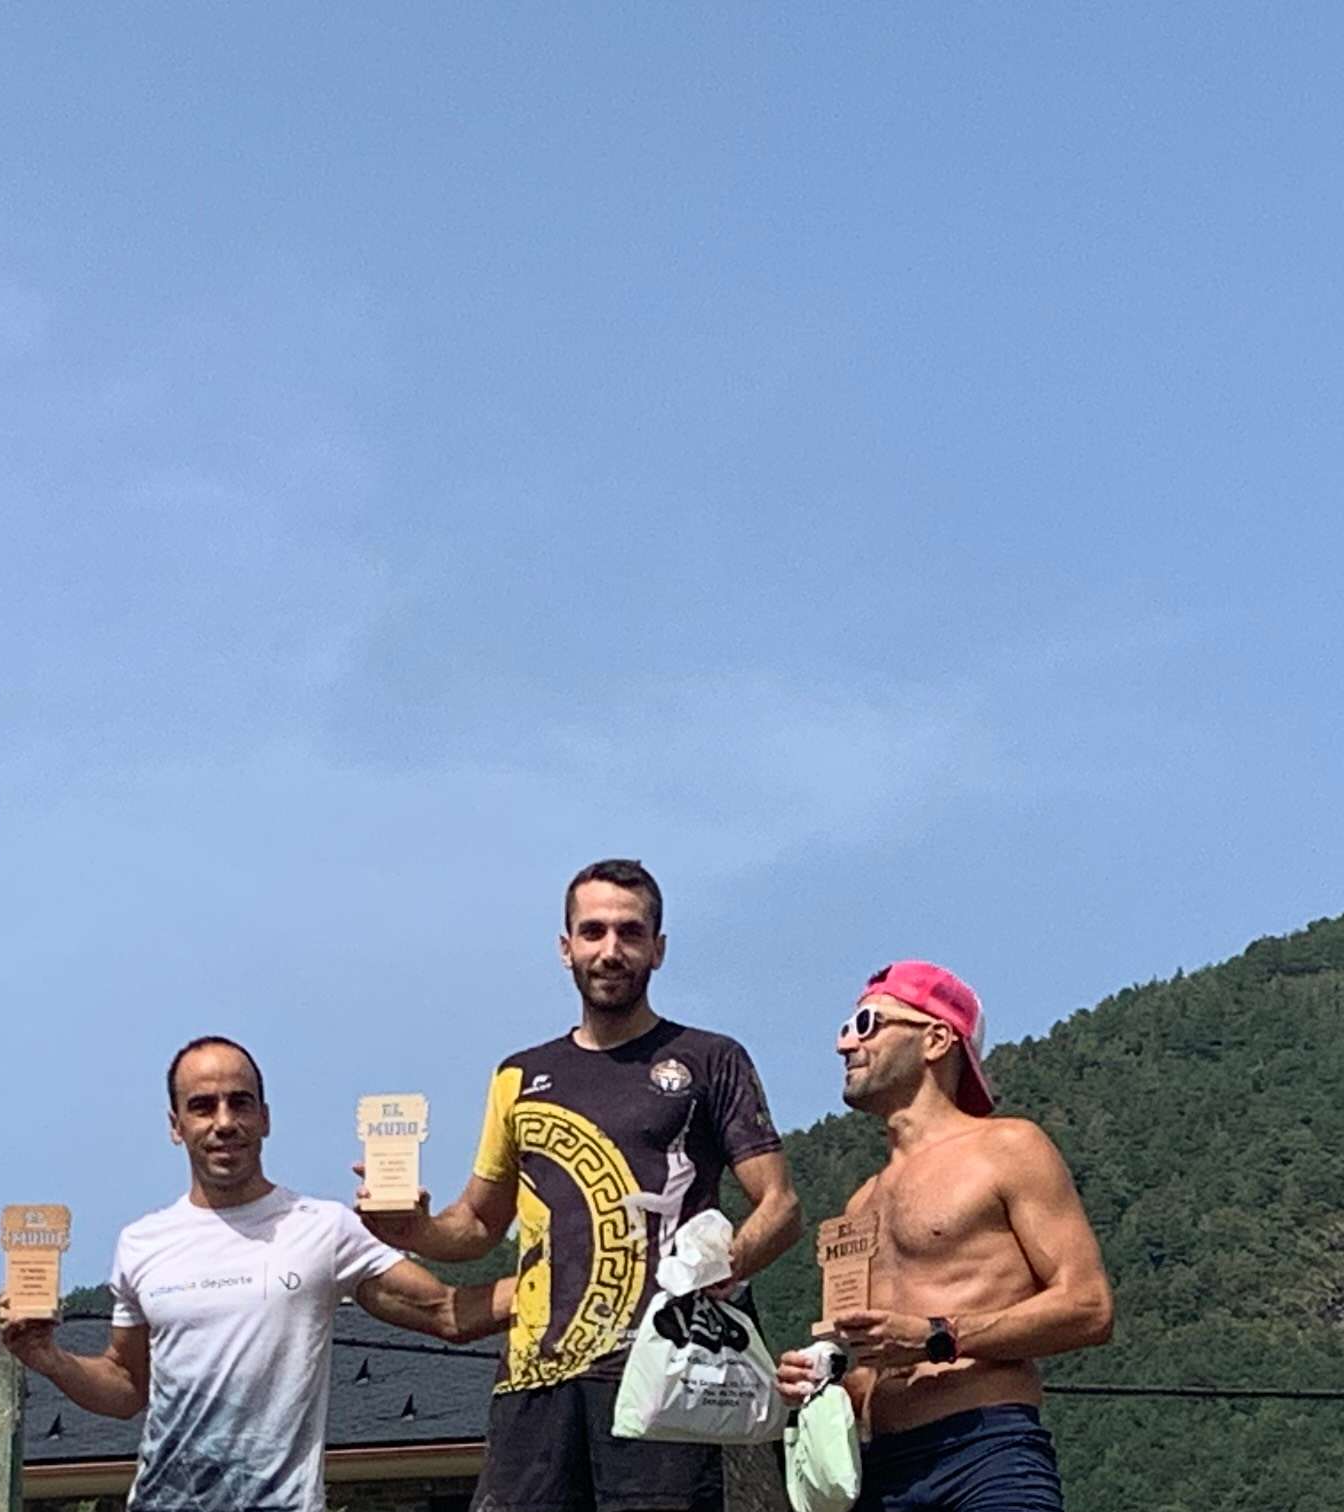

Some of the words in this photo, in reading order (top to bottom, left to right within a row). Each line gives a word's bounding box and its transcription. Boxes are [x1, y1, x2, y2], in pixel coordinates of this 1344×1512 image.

[382, 1103, 404, 1117] EL
[367, 1121, 418, 1137] MURO
[838, 1222, 856, 1239] EL
[825, 1238, 868, 1262] MURO
